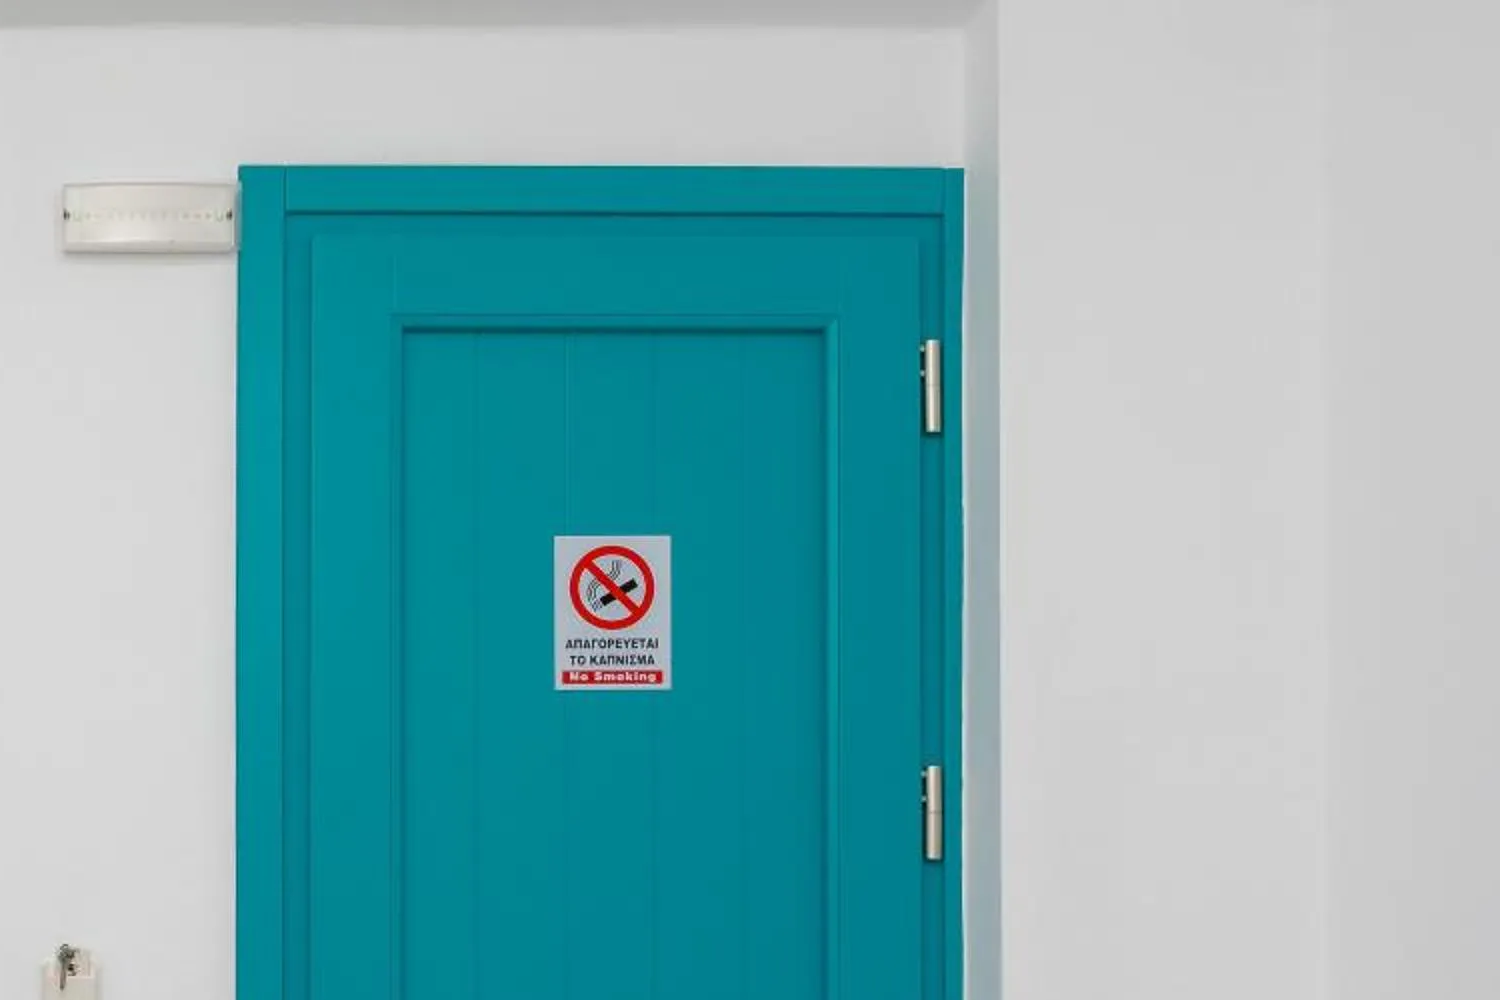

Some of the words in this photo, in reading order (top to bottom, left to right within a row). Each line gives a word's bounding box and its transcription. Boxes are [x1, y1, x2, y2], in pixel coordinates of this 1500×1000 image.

[565, 638, 660, 650] ΑΠΑΓΟΡΕΥΕΤΑΙ
[570, 655, 587, 667] ΤΟ
[589, 655, 656, 667] ΚΑΠΝΙΣΜΑ
[569, 671, 589, 681] No
[594, 671, 657, 683] Smoking
